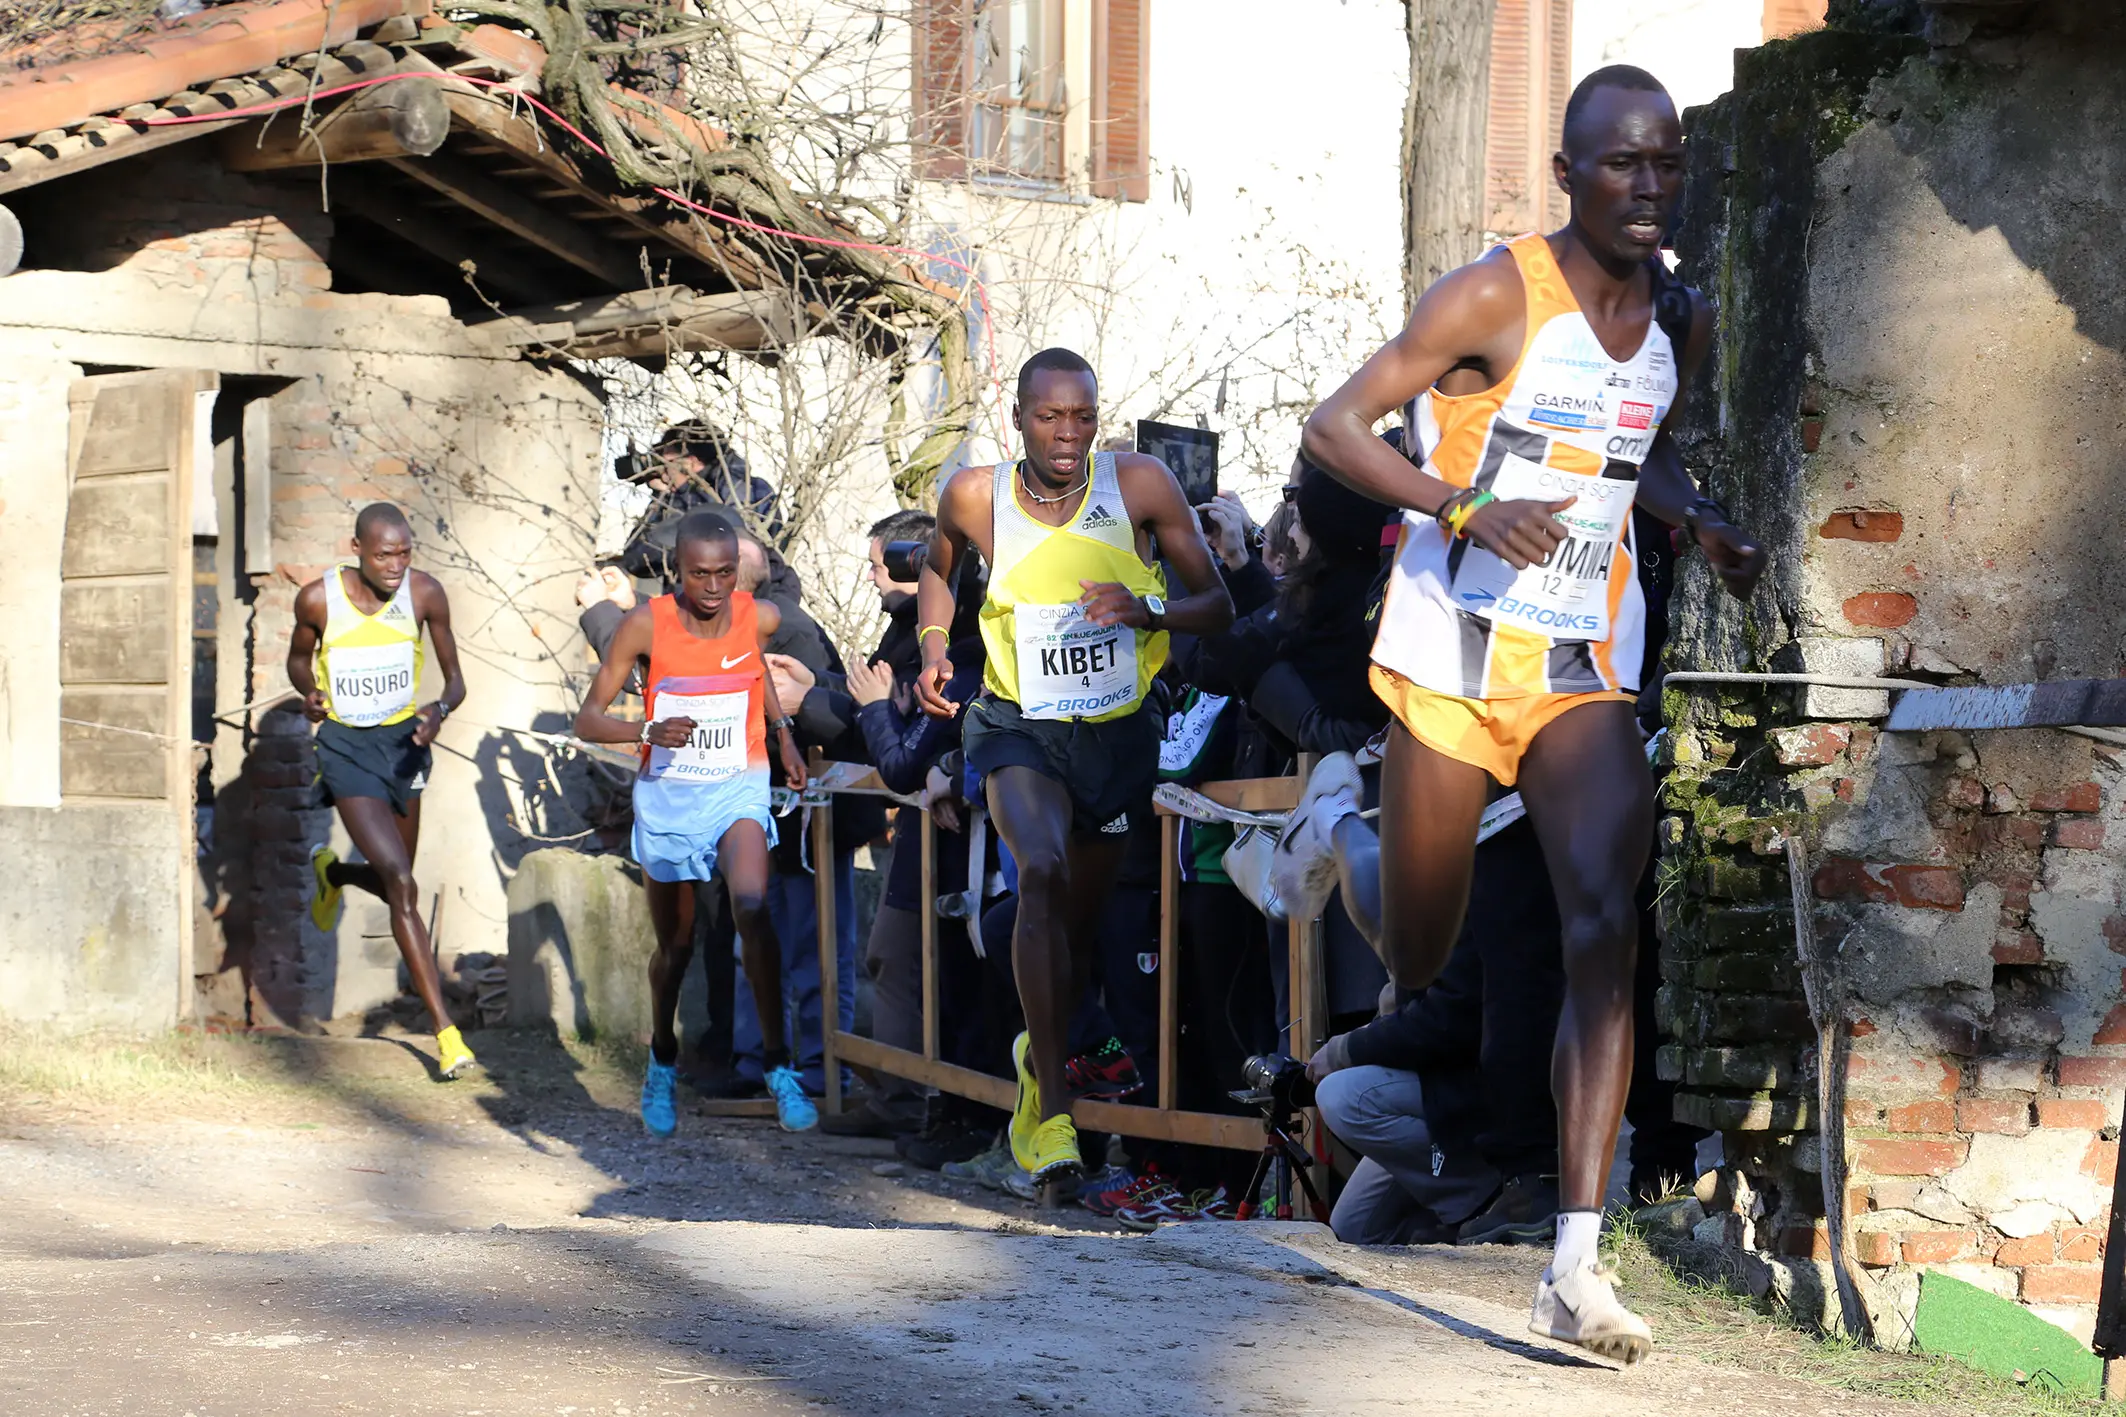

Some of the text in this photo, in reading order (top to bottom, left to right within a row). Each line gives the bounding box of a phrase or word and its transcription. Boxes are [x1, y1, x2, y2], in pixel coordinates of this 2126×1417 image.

[1534, 393, 1606, 413] GARMIN
[1538, 473, 1586, 494] CINZIA
[1082, 517, 1118, 530] adidas
[1542, 574, 1562, 596] 12
[1039, 606, 1080, 619] CINZIA
[1498, 597, 1600, 630] BROOKS
[1041, 638, 1118, 676] KIBET
[336, 670, 409, 697] KUSURO
[1081, 676, 1091, 688] 4
[1057, 685, 1133, 712] BROOKS
[685, 726, 732, 749] ANUI
[699, 751, 706, 760] 6
[677, 764, 741, 777] BROOKS
